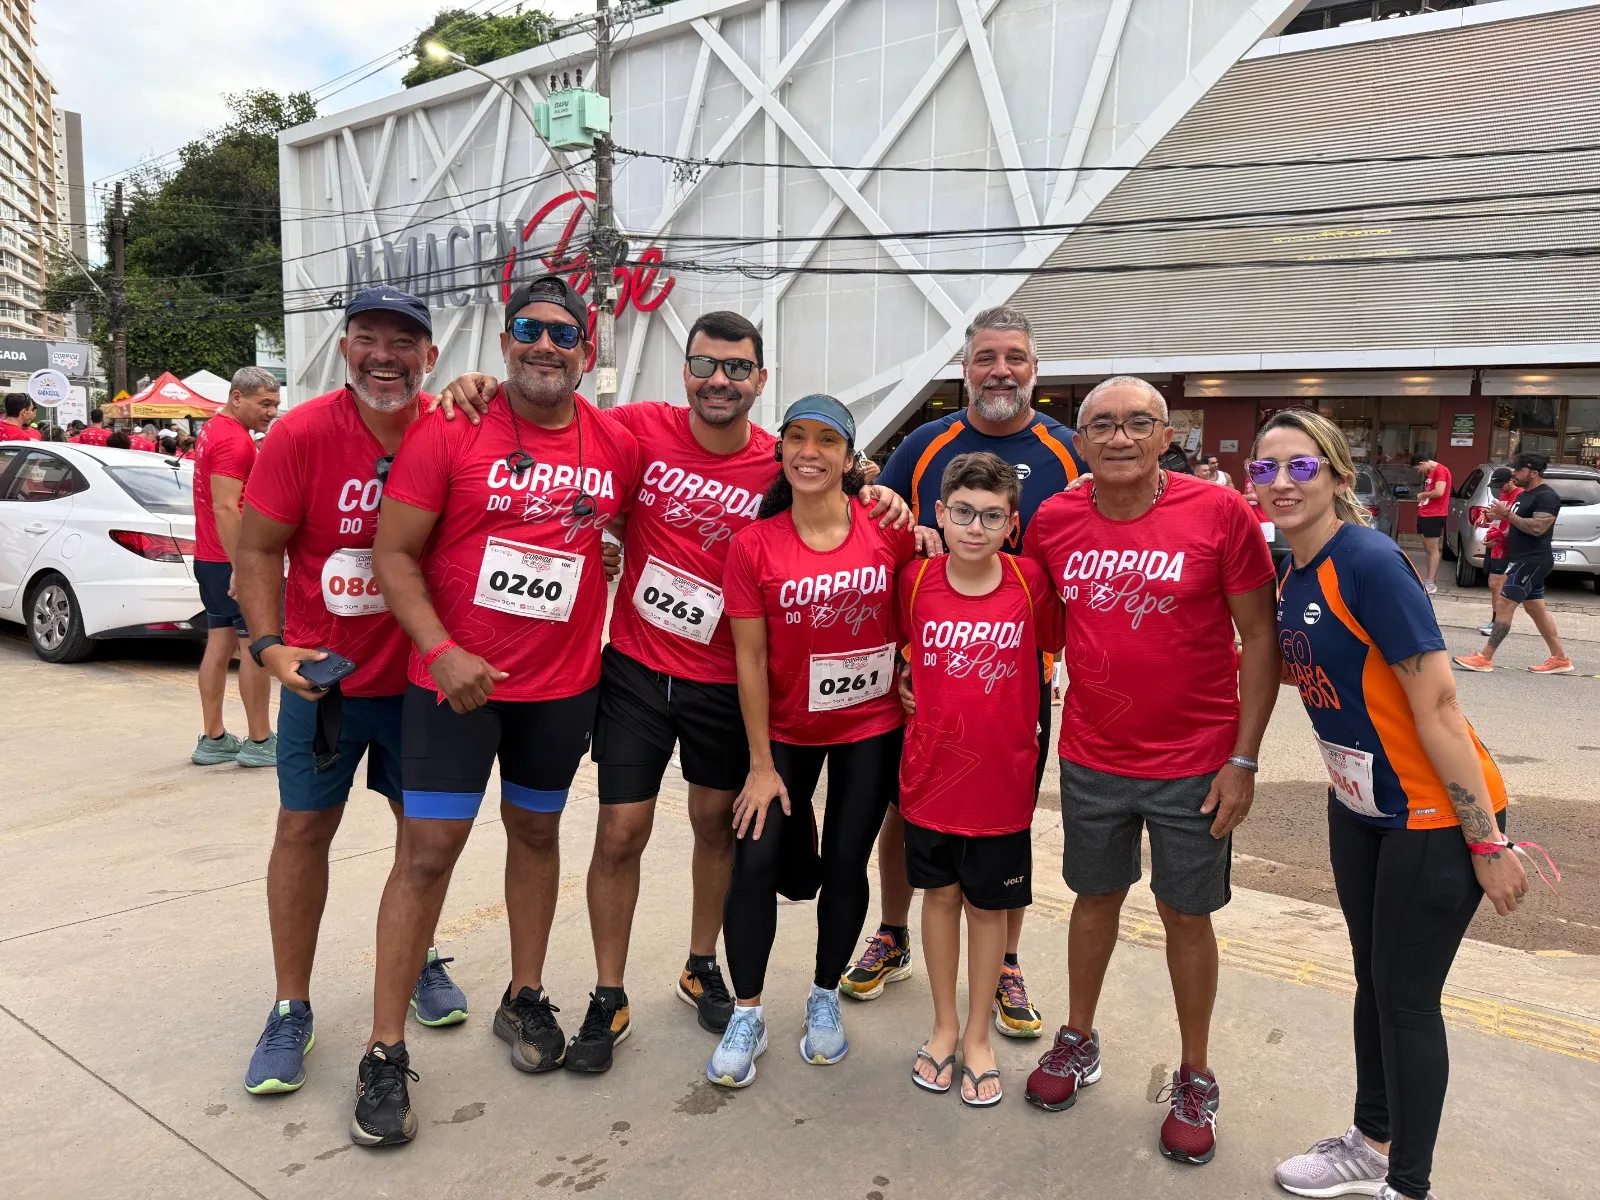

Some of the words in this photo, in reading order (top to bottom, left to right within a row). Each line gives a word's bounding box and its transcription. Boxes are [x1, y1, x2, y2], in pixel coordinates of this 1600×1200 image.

[487, 459, 614, 499] CORRIDA
[643, 460, 764, 521] CORRIDA
[486, 494, 512, 512] DO
[637, 488, 656, 506] DO
[672, 498, 735, 551] Pep
[339, 517, 363, 535] DO
[1063, 549, 1186, 582] CORRIDA
[328, 575, 382, 597] 086
[489, 570, 562, 602] 0260
[780, 564, 887, 608] CORRIDA
[1063, 585, 1079, 600] DO
[1099, 570, 1179, 630] Pepe
[643, 586, 705, 626] 0263
[786, 611, 801, 624] DO
[821, 588, 882, 636] Pepe
[922, 620, 1025, 649] CORRIDA
[819, 670, 879, 696] 0261
[923, 652, 937, 667] DO
[954, 640, 1018, 695] Pepe
[1298, 684, 1342, 710] HON
[1003, 875, 1025, 888] VOLT
